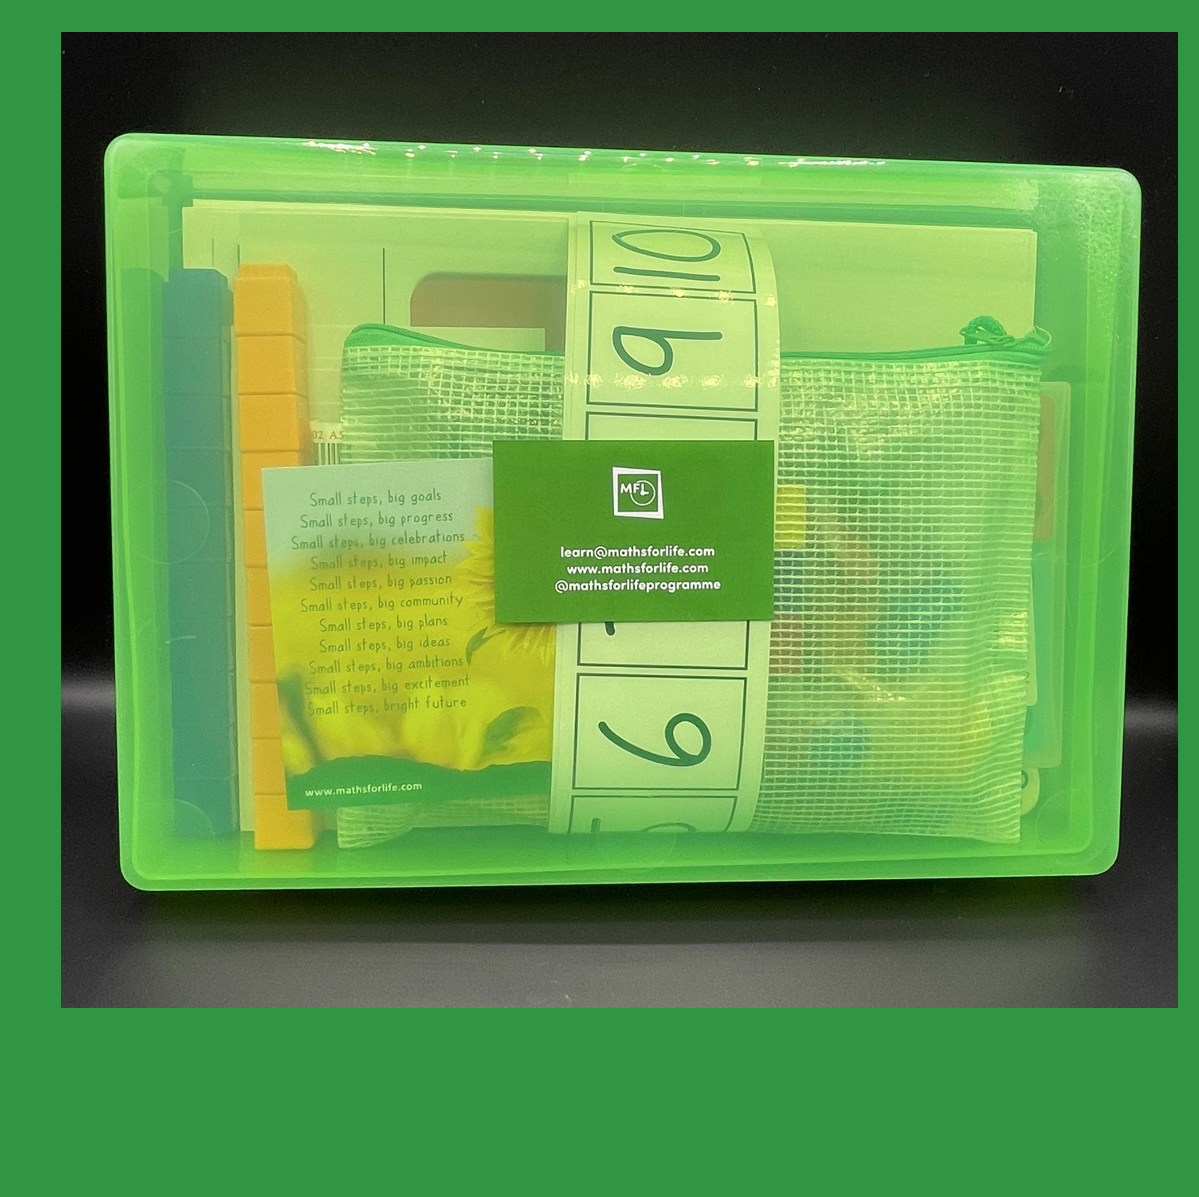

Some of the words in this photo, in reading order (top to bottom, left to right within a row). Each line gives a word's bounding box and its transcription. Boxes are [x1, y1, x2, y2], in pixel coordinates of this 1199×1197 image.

[611, 227, 722, 282] 10
[611, 324, 723, 376] 9
[310, 491, 342, 507] Small
[347, 491, 382, 507] steps,
[388, 489, 405, 506] big
[411, 487, 441, 506] goals
[620, 482, 650, 496] MFL
[300, 513, 332, 529] Small
[338, 512, 373, 528] steps,
[378, 511, 395, 527] big
[401, 513, 453, 527] progress
[291, 535, 323, 550] Small
[329, 534, 364, 550] steps,
[369, 532, 386, 549] big
[391, 529, 465, 545] celebrations
[310, 554, 342, 570] Small
[348, 555, 383, 570] steps,
[388, 552, 405, 569] big
[411, 550, 447, 567] impact
[560, 545, 715, 560] learn@mathsforlife.com
[566, 562, 709, 575] www.mathsforlife.com
[309, 575, 342, 591] Small
[347, 575, 382, 591] steps,
[387, 573, 404, 590] big
[410, 576, 452, 589] passion
[554, 578, 721, 594] @mathsforlifeprogramme
[300, 597, 332, 613] Small
[337, 597, 373, 612] steps,
[378, 595, 395, 611] big
[400, 591, 464, 608] community
[319, 617, 351, 633] Small
[357, 617, 391, 632] steps,
[396, 614, 413, 631] big
[419, 613, 448, 630] plans
[319, 638, 351, 653] Small
[357, 638, 391, 653] steps,
[396, 635, 413, 652] big
[419, 634, 450, 648] ideas
[309, 659, 341, 674] Small
[346, 659, 381, 674] steps,
[386, 657, 403, 673] big
[408, 654, 463, 669] ambitions
[305, 680, 336, 695] Small
[342, 680, 376, 695] steps,
[381, 677, 398, 694] big
[404, 673, 469, 690] excitement
[308, 701, 339, 716] Small
[344, 699, 378, 715] steps,
[384, 697, 419, 714] bright
[598, 712, 713, 767] 6
[304, 780, 423, 797] www.mathsforlife.com
